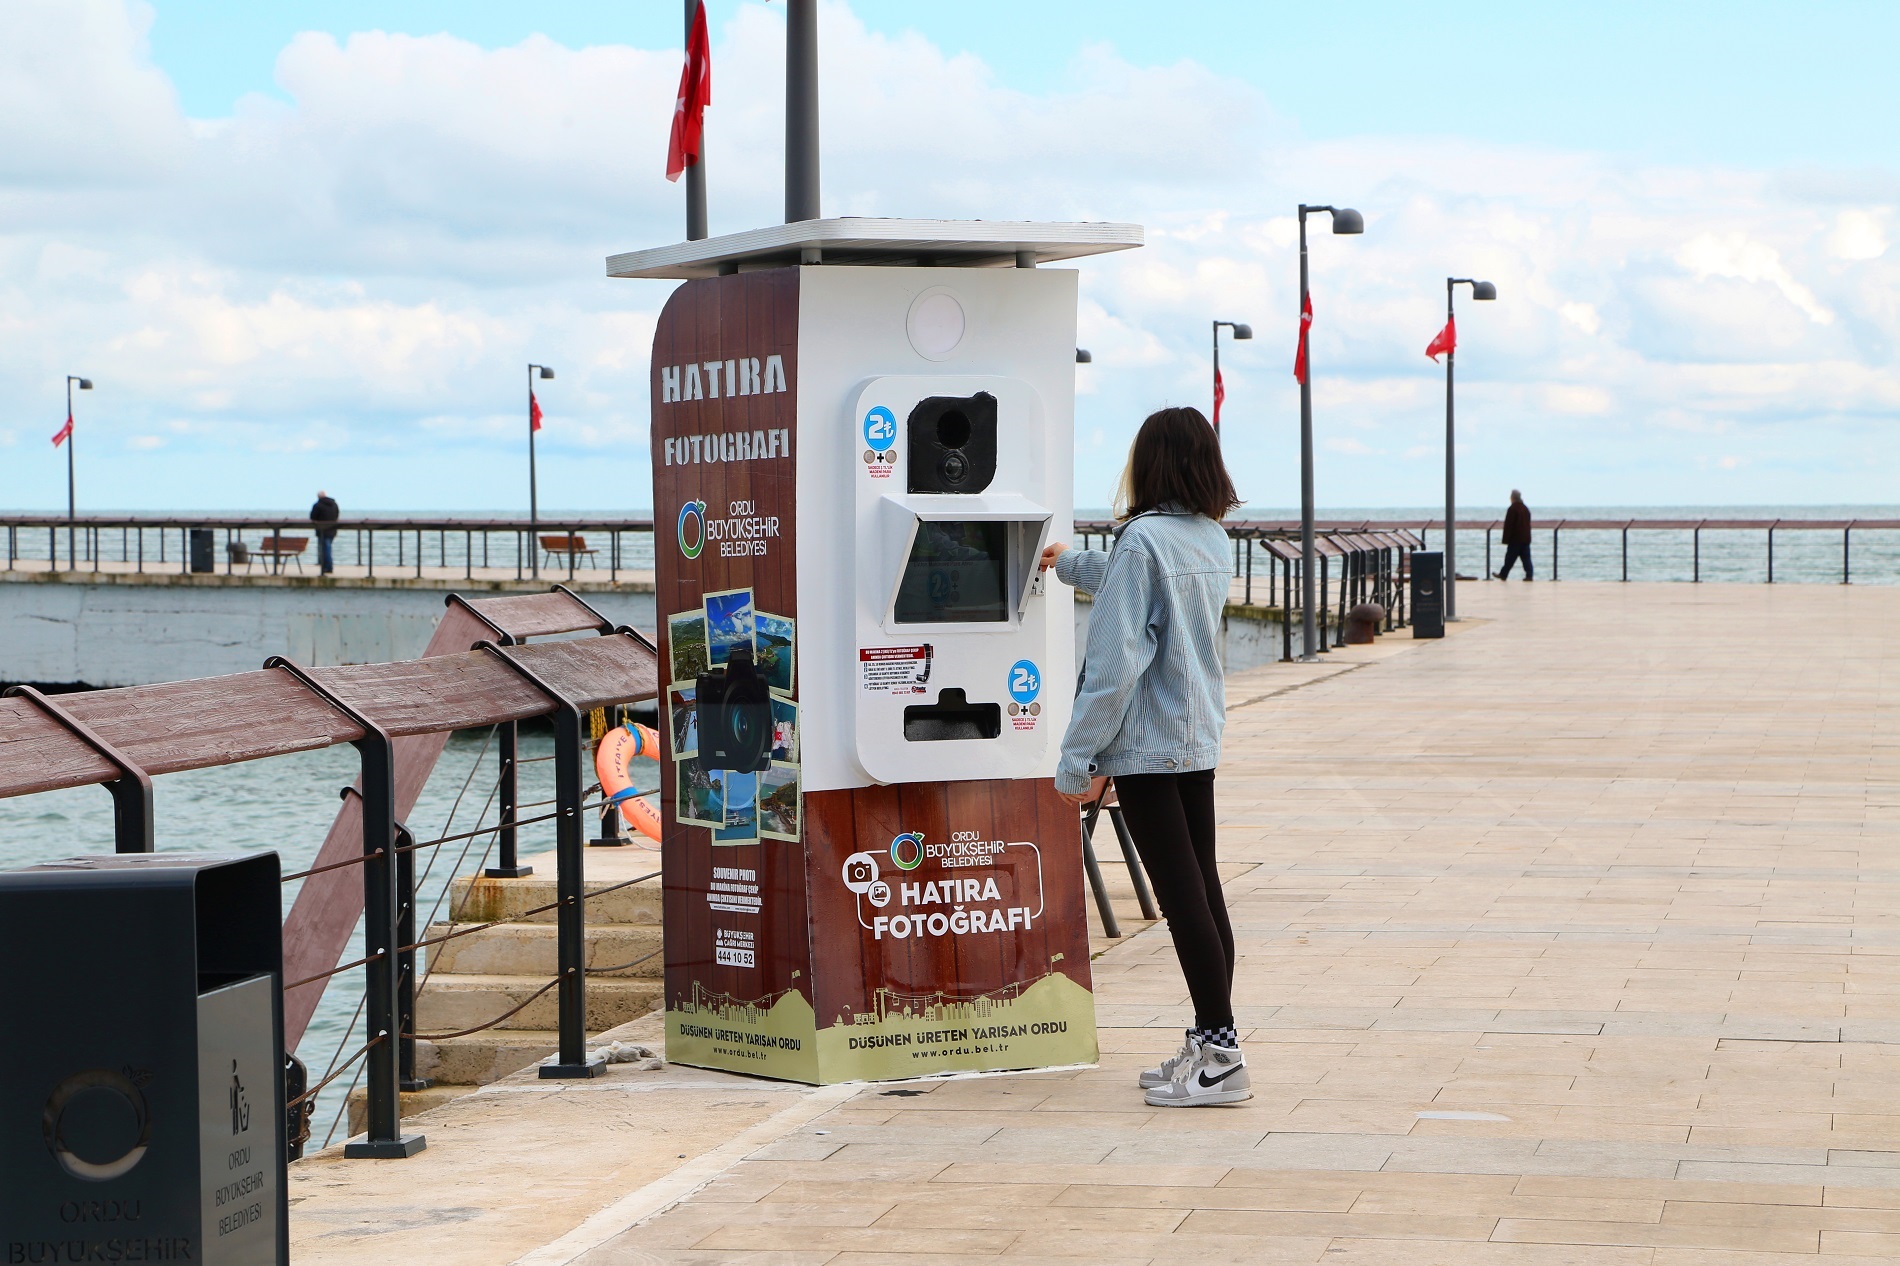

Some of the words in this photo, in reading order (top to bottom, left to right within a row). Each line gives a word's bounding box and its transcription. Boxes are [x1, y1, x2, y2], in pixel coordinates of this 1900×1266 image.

[662, 354, 787, 403] HATIRA
[729, 500, 755, 516] ORDU
[707, 516, 780, 540] BÜYÜKŞEHİR
[720, 540, 767, 558] BELEDİYESİ
[952, 831, 980, 842] ORDU
[926, 840, 1006, 858] BÜYÜKŞEHİR
[941, 855, 993, 868] BELEDİYESİ
[713, 866, 739, 881] SOUVENIR
[739, 868, 756, 882] PHOTO
[900, 877, 1002, 906] HATIRA
[873, 905, 1032, 940] FOTOĞRAFI
[717, 950, 731, 962] 444
[733, 952, 742, 963] 10
[743, 953, 753, 965] 52
[680, 1023, 713, 1039] DÜŞÜNEN
[715, 1028, 744, 1043] ÜRETEN
[745, 1032, 777, 1048] YARIŞAN
[778, 1037, 801, 1051] ORDU
[849, 1033, 911, 1050] DÜŞÜNEN
[917, 1029, 968, 1044] ÜRETEN
[971, 1024, 1028, 1040] YARIŞAN
[1031, 1021, 1068, 1034] ORDU
[713, 1046, 767, 1060] www.ordu.bel.tr
[912, 1043, 1009, 1059] www.ordu.bel.tr
[229, 1146, 251, 1171] ORDU
[215, 1171, 264, 1207] BÜYÜKŞEHİR
[59, 1199, 141, 1223] ORDU
[219, 1201, 262, 1237] BELEDİYESİ
[8, 1237, 192, 1265] BÜYÜKŞEHİR
